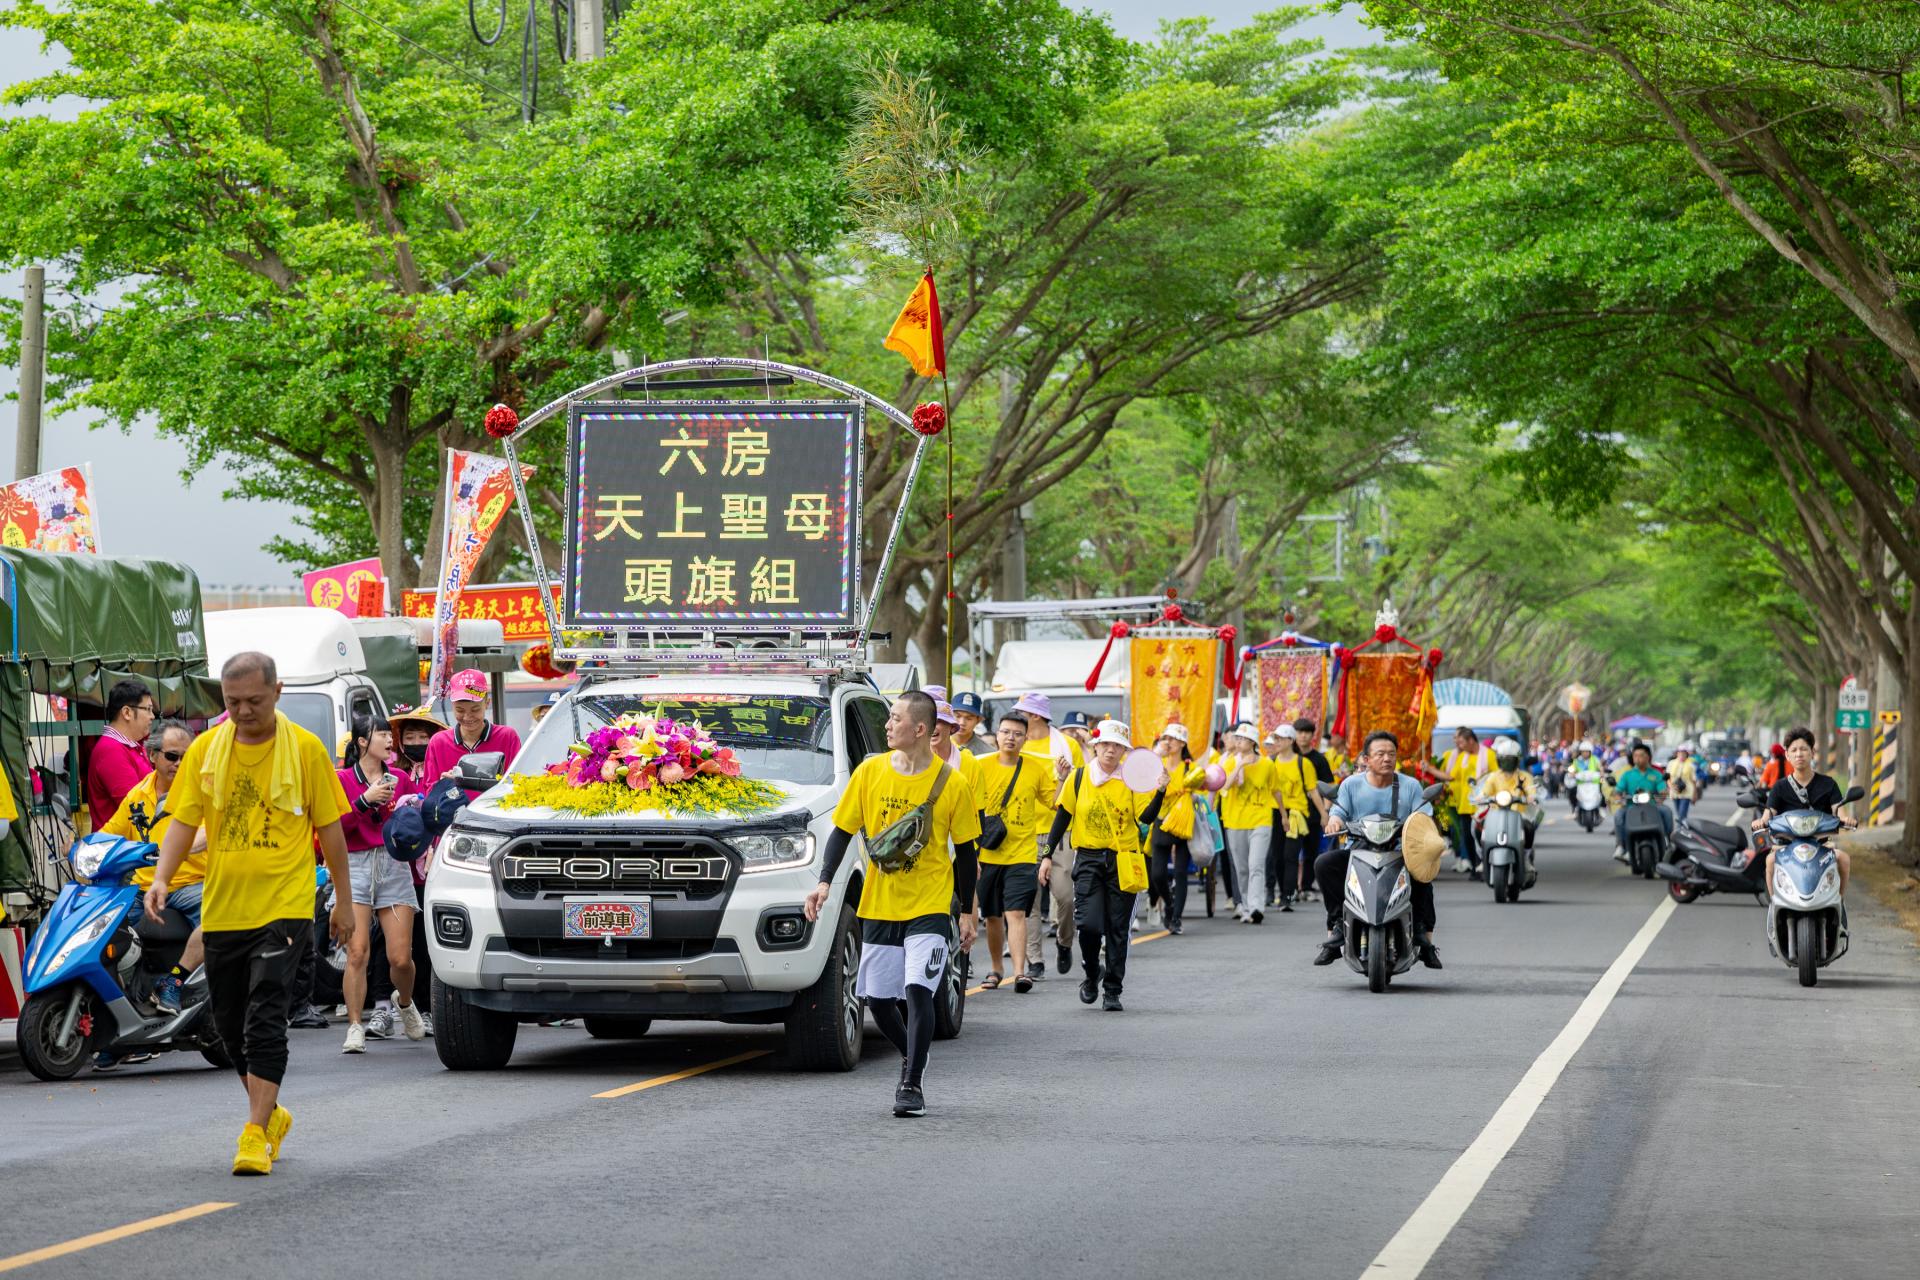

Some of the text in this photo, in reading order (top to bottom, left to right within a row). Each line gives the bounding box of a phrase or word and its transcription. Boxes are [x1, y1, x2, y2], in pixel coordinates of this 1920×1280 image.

[658, 427, 771, 477] 六房
[593, 492, 833, 541] 天上聖母
[623, 555, 800, 606] 頭旗組
[503, 856, 729, 880] FORD
[582, 911, 632, 930] 前導車
